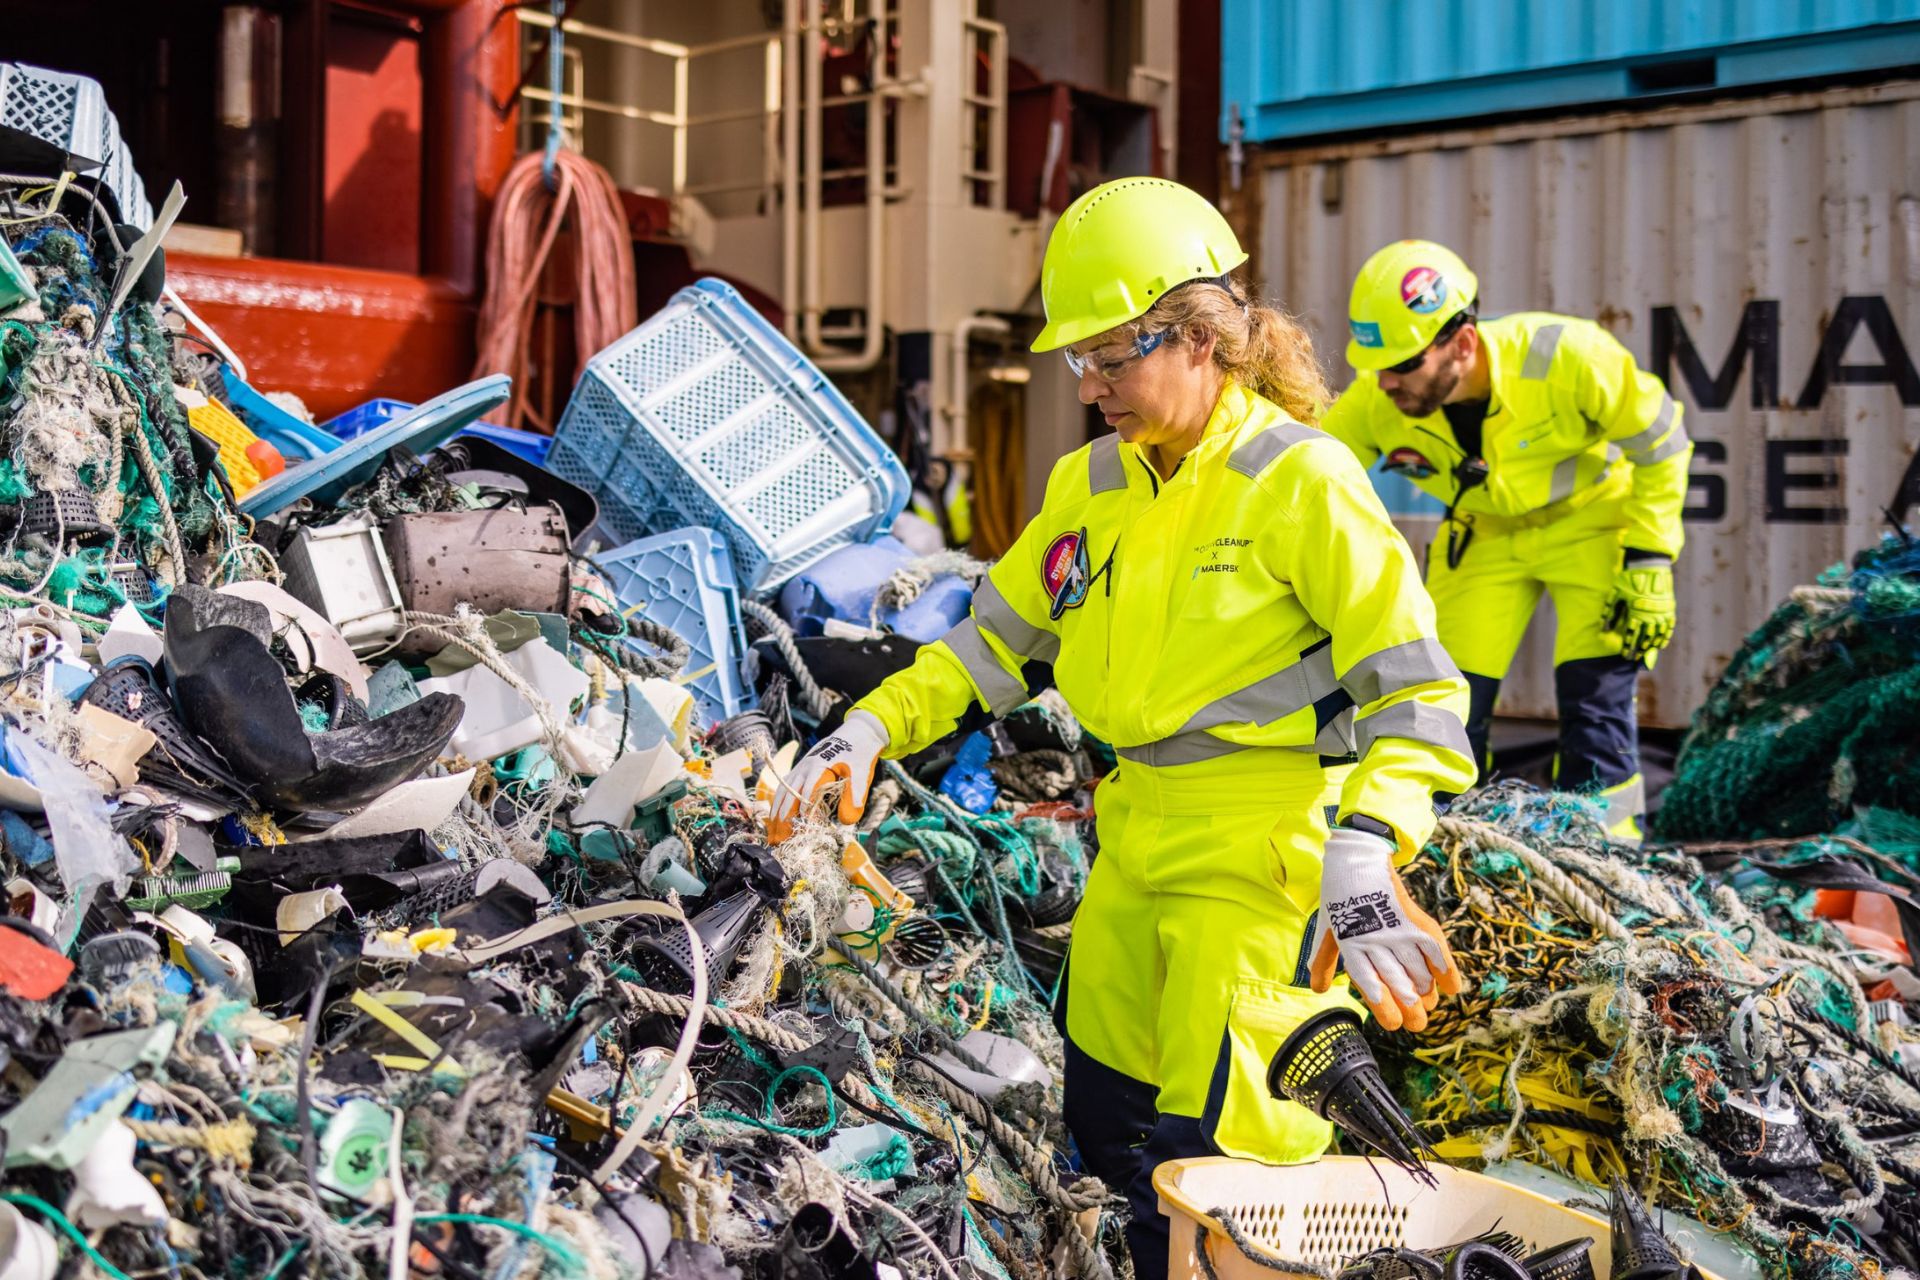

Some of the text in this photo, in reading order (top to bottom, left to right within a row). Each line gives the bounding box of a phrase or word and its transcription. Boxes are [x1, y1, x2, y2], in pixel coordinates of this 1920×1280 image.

[1050, 542, 1071, 581] SYSTEM
[1200, 564, 1240, 573] MAERSK
[819, 744, 845, 762] 9014
[1375, 899, 1401, 928] 9014
